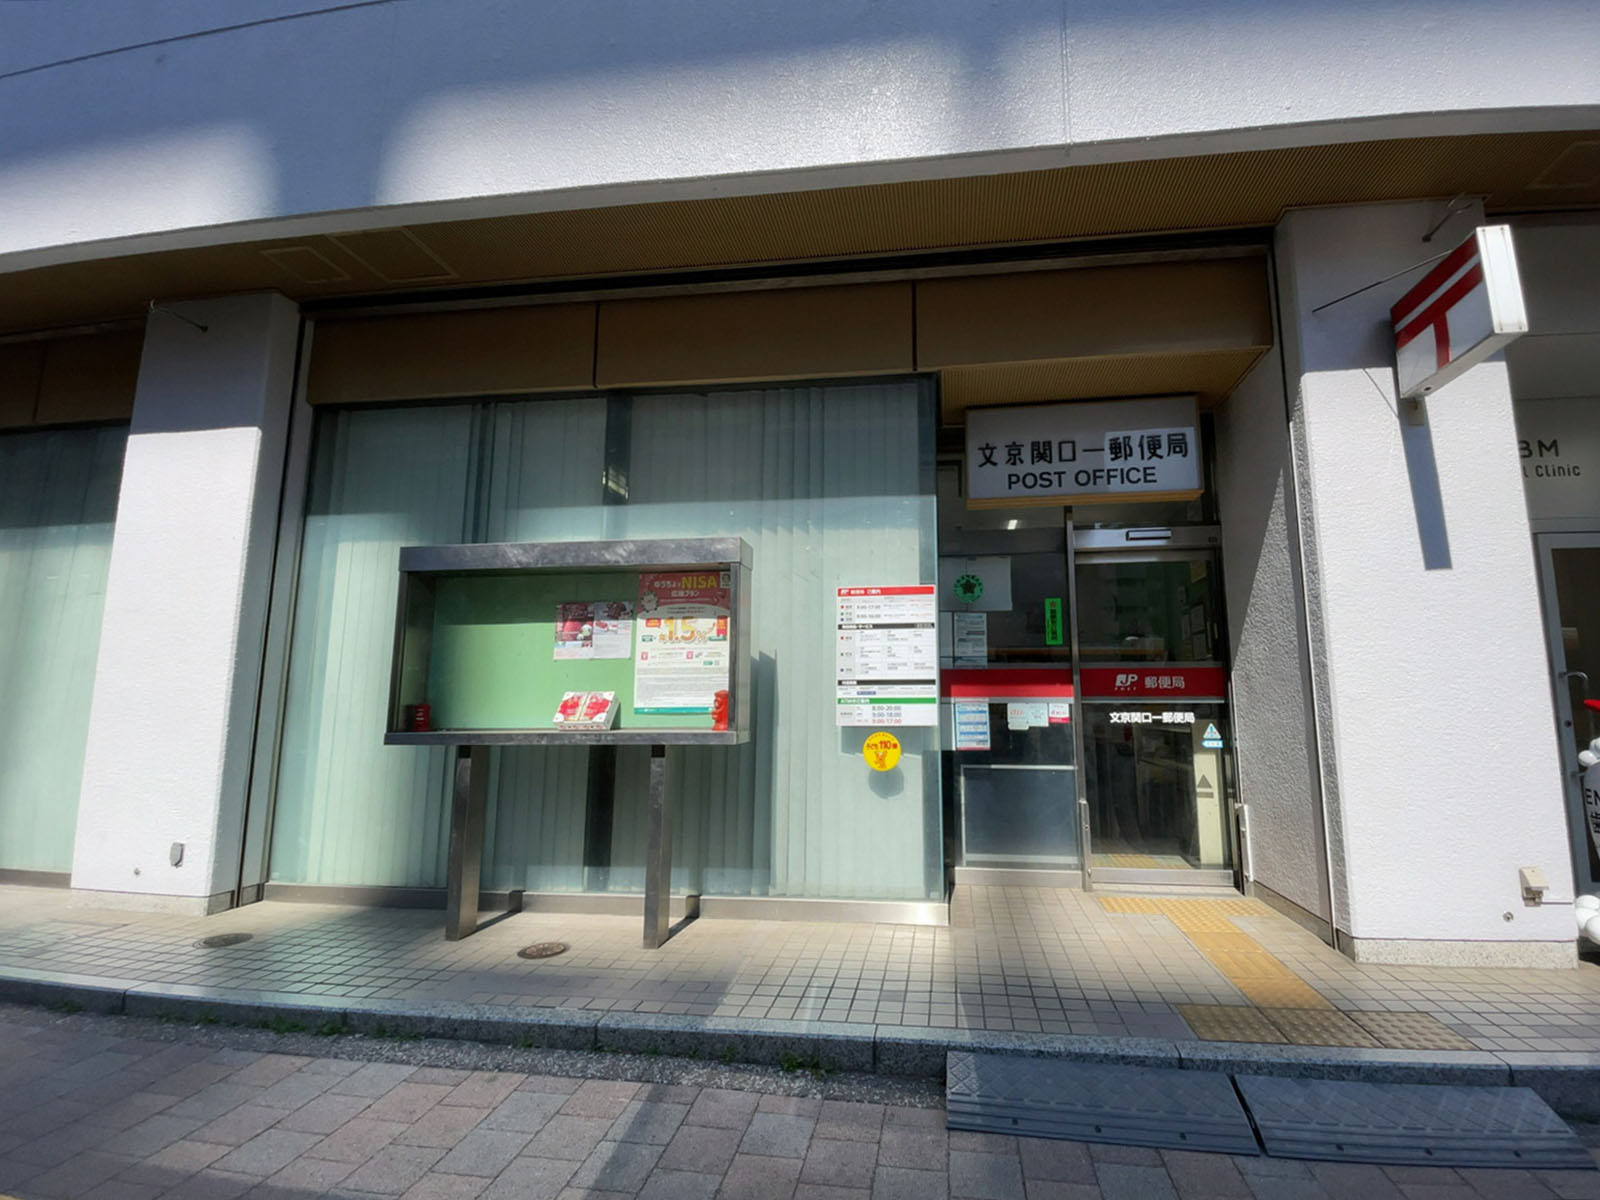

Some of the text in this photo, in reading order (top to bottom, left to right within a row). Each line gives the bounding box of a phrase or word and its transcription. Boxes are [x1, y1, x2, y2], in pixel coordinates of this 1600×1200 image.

[978, 432, 1189, 468] 文京関口一郵便局
[1535, 463, 1581, 477] Clinic
[1007, 466, 1158, 491] POST OFFICE
[681, 575, 717, 589] NISA
[1144, 675, 1186, 689] 郵便局
[1109, 711, 1196, 724] 文京関口一郵便局
